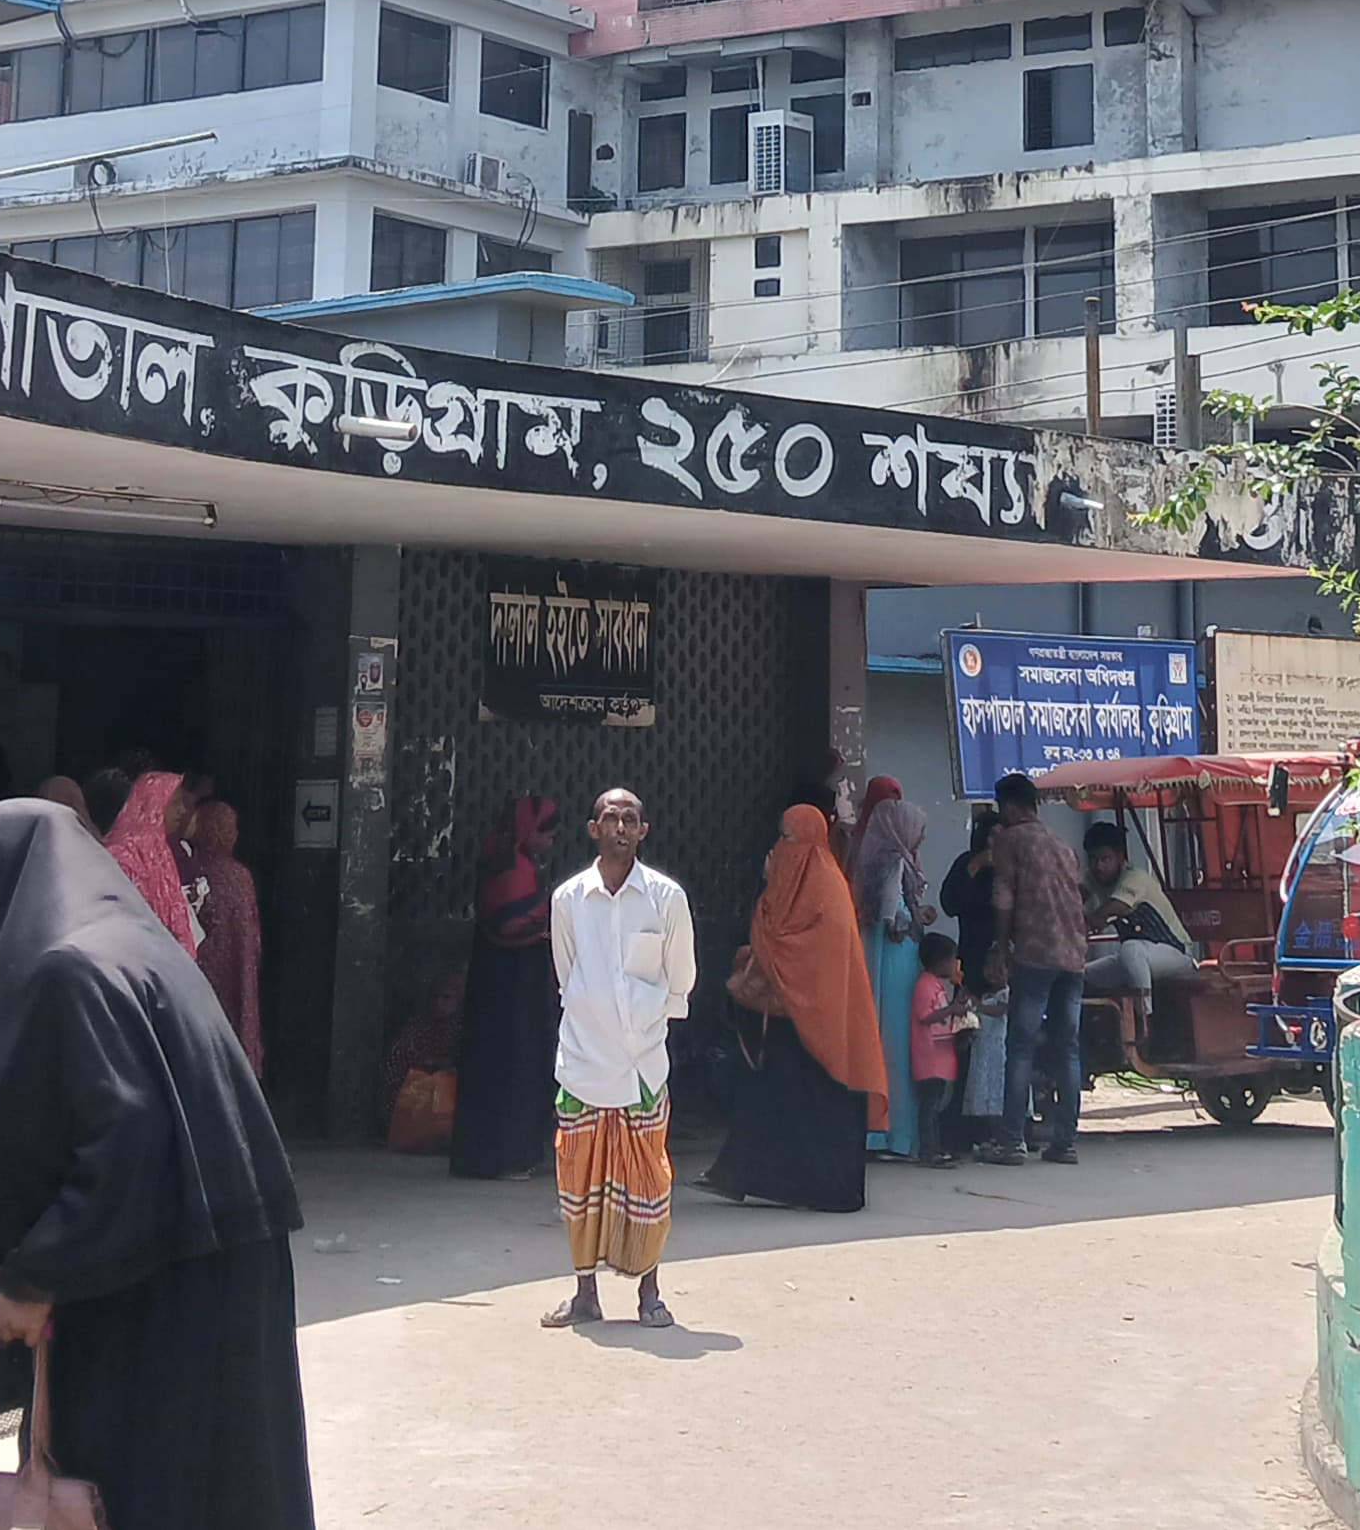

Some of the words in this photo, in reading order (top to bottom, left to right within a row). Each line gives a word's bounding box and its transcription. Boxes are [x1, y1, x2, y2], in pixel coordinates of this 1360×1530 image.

[243, 341, 608, 491] কুড়িগ্রাম,
[638, 395, 834, 501] ২৫০
[490, 583, 540, 667] দালাল
[545, 571, 591, 678] হইতে
[595, 590, 650, 673] সাবধান
[1017, 665, 1082, 686] সমাজসেবা
[1084, 664, 1136, 687] অধিদপ্তর
[960, 695, 1026, 739] হাসপাতাল
[1028, 698, 1092, 738] সমাজসেবা
[1094, 691, 1145, 745] কার্যালয়,
[1147, 694, 1193, 748] কুড়িগ্রাম
